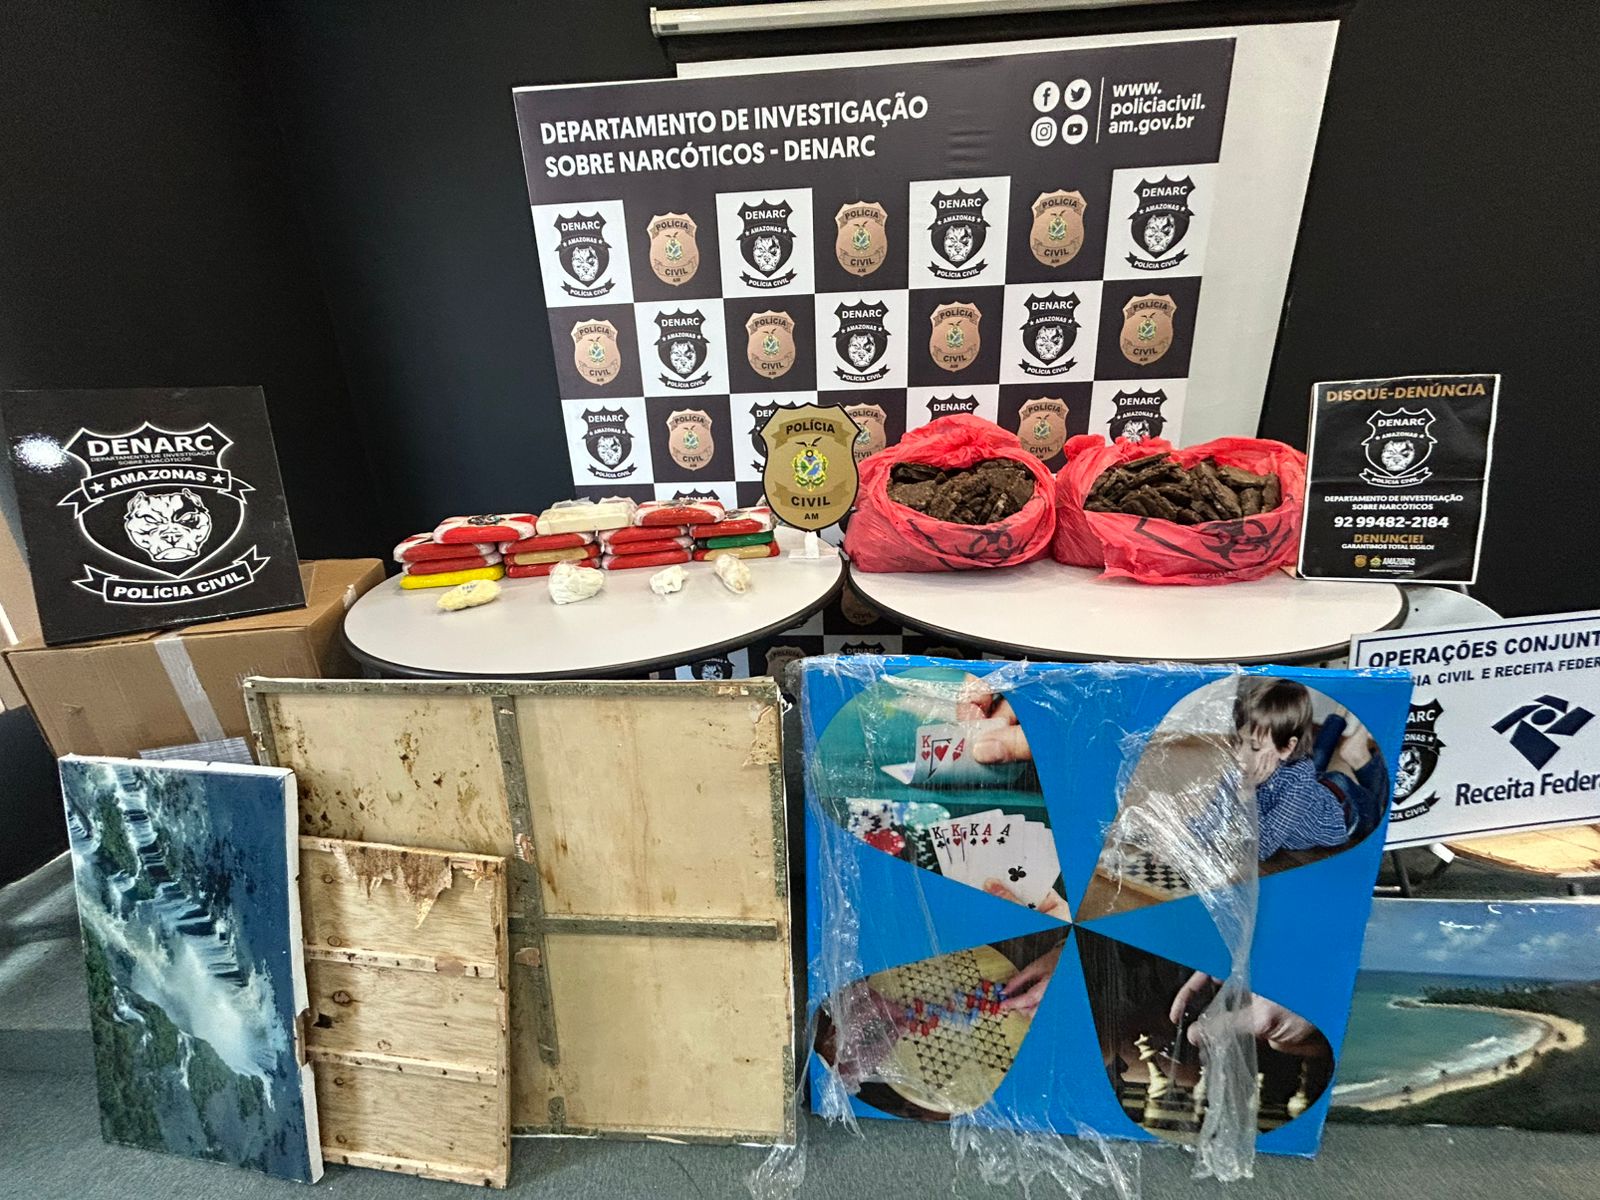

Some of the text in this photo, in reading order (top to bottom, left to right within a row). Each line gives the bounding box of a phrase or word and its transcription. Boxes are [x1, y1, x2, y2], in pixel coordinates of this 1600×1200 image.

[1113, 81, 1162, 97] www.
[1111, 94, 1206, 118] policiacivil.
[540, 92, 928, 144] DEPARTAMENTO DE INVESTIGAÇÃO
[1109, 115, 1194, 135] am.gov.br
[546, 156, 615, 178] SOBRE
[620, 142, 764, 172] NARCÓTICOS
[784, 136, 875, 161] DENARC
[1142, 186, 1187, 197] DENARC
[939, 198, 981, 209] DENARC
[1042, 197, 1077, 208] POLÍCIA
[745, 209, 786, 219] DENARC
[845, 208, 879, 219] POLÍCIA
[561, 221, 600, 231] DENARC
[656, 221, 689, 231] POLÍCIA
[1161, 260, 1178, 268] CIVIL
[773, 278, 789, 286] CIVIL
[1032, 301, 1073, 310] DENARC
[1133, 301, 1168, 311] POLÍCIA
[842, 309, 882, 319] DENARC
[940, 308, 973, 319] POLÍCIA
[661, 318, 699, 327] DENARC
[755, 316, 787, 327] POLÍCIA
[579, 326, 610, 335] POLÍCIA
[1052, 366, 1068, 374] CIVIL
[867, 373, 882, 381] CIVIL
[1327, 383, 1486, 402] DISQUE-DENÚNCIA
[933, 402, 973, 412] DENARC
[1120, 397, 1160, 406] DENARC
[1029, 404, 1061, 413] POLÍCIA
[588, 415, 624, 423] DENARC
[675, 415, 705, 424] POLÍCIA
[1378, 418, 1425, 426] DENARC
[786, 419, 835, 434] POLÍCIA
[88, 435, 214, 457] DENARC
[110, 469, 207, 488] AMAZONAS
[791, 496, 830, 507] CIVIL
[1401, 494, 1463, 503] INVESTIGAÇÃO
[1334, 517, 1449, 527] 92 99482-2184
[1354, 534, 1424, 543] DENUNCIE!
[113, 572, 244, 598] POLÍCIA CIVIL
[1369, 640, 1497, 667] OPERAÇÕES
[1438, 670, 1474, 684] CIVIL
[1482, 668, 1490, 679] E
[1495, 662, 1553, 678] RECEITA
[1406, 710, 1435, 723] ARC
[922, 736, 965, 752] K A
[1455, 778, 1533, 806] Receita
[1405, 806, 1428, 817] CIVIL
[932, 824, 1011, 838] K K K A A
